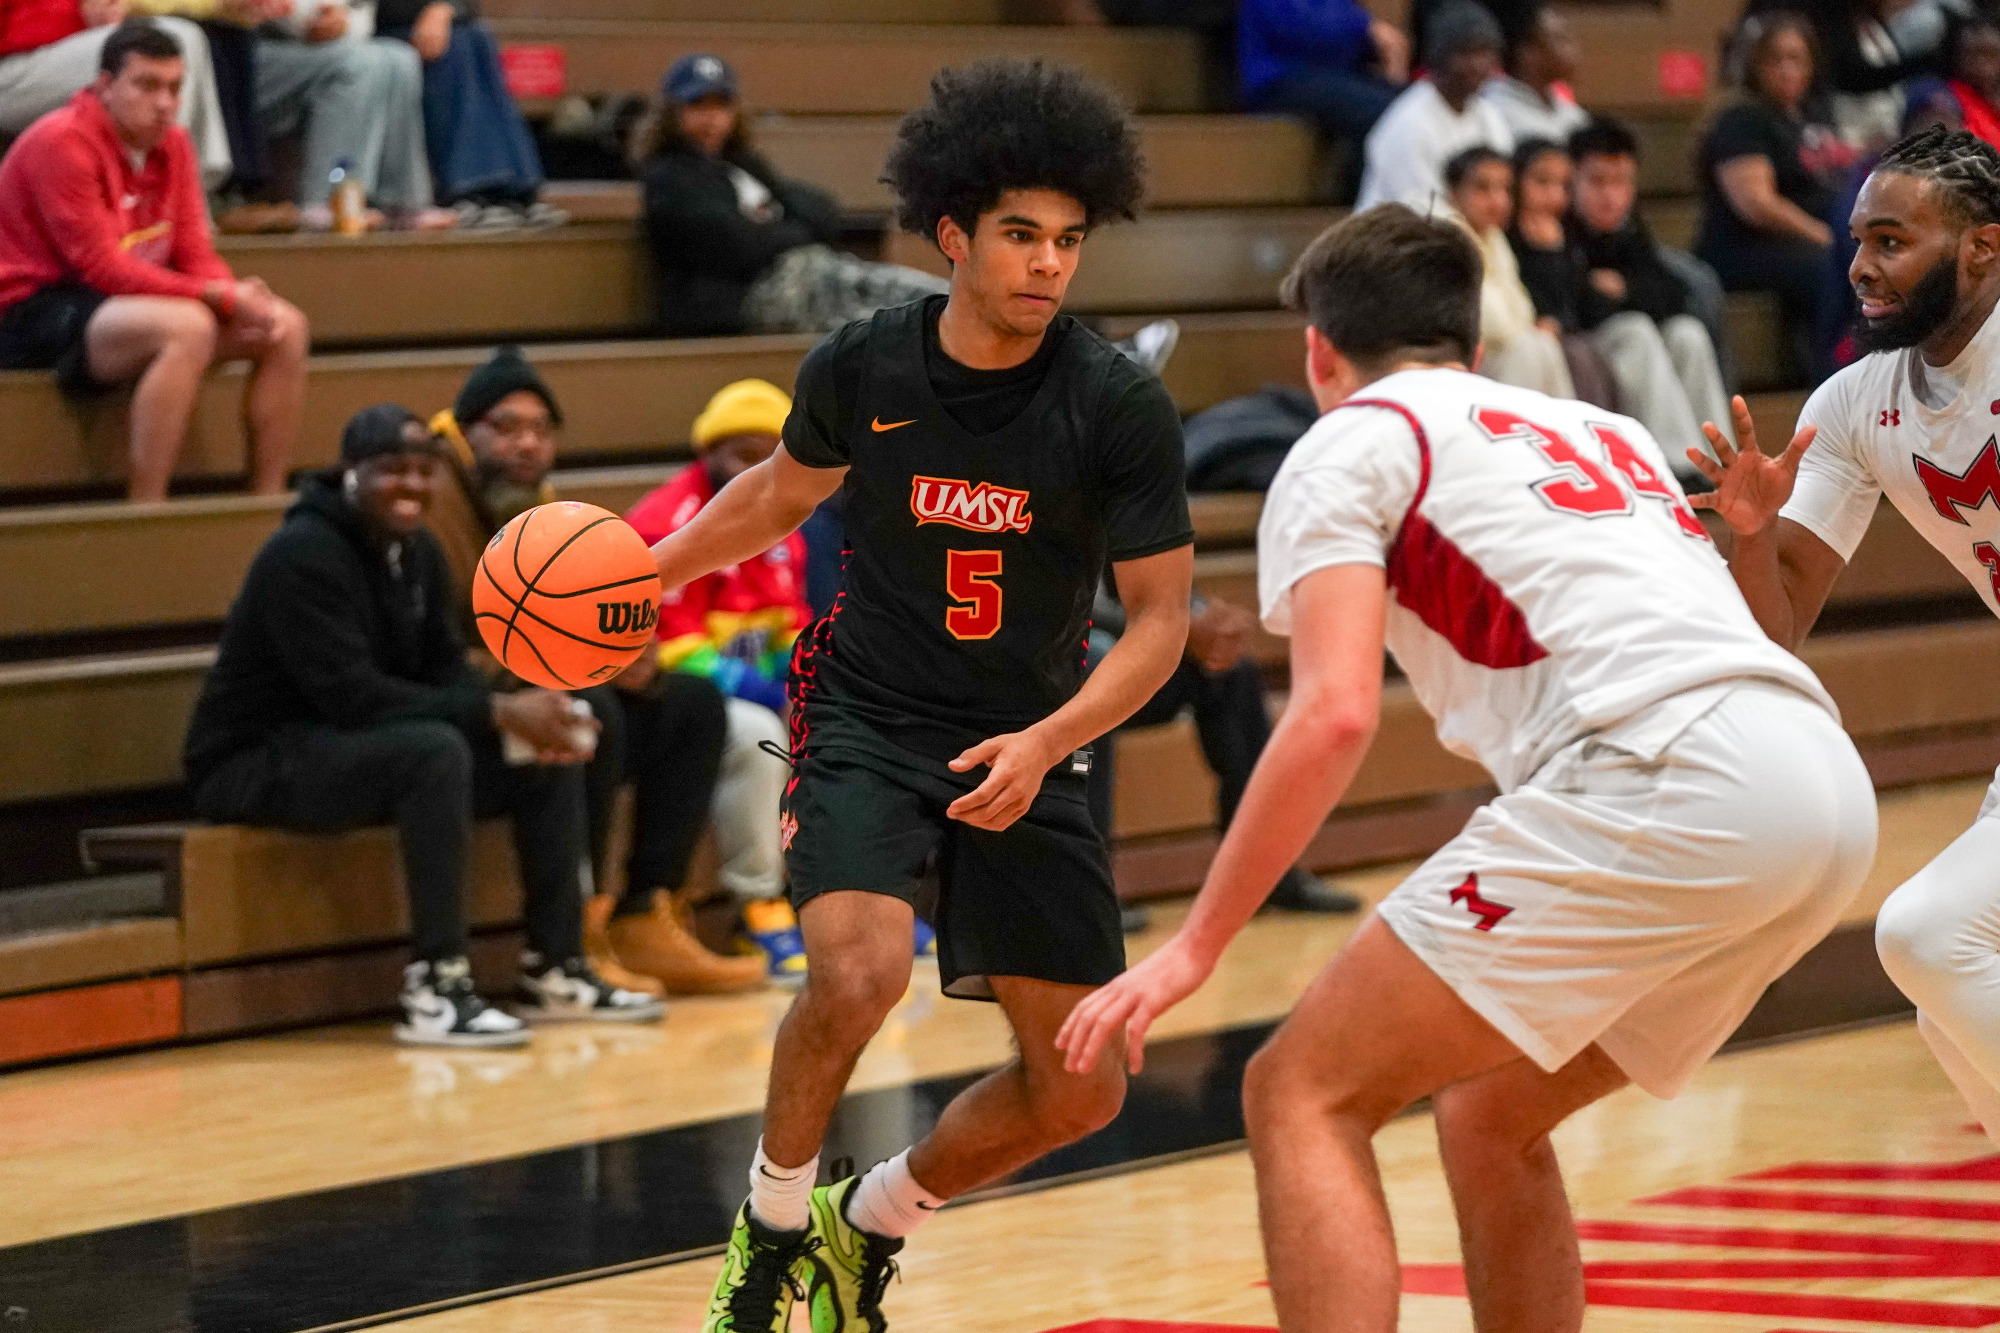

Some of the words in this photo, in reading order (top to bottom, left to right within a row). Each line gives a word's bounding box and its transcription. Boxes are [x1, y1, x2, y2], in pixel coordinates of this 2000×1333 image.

[913, 477, 1029, 533] UMSL
[1469, 404, 1711, 542] 34
[946, 549, 1002, 640] 5
